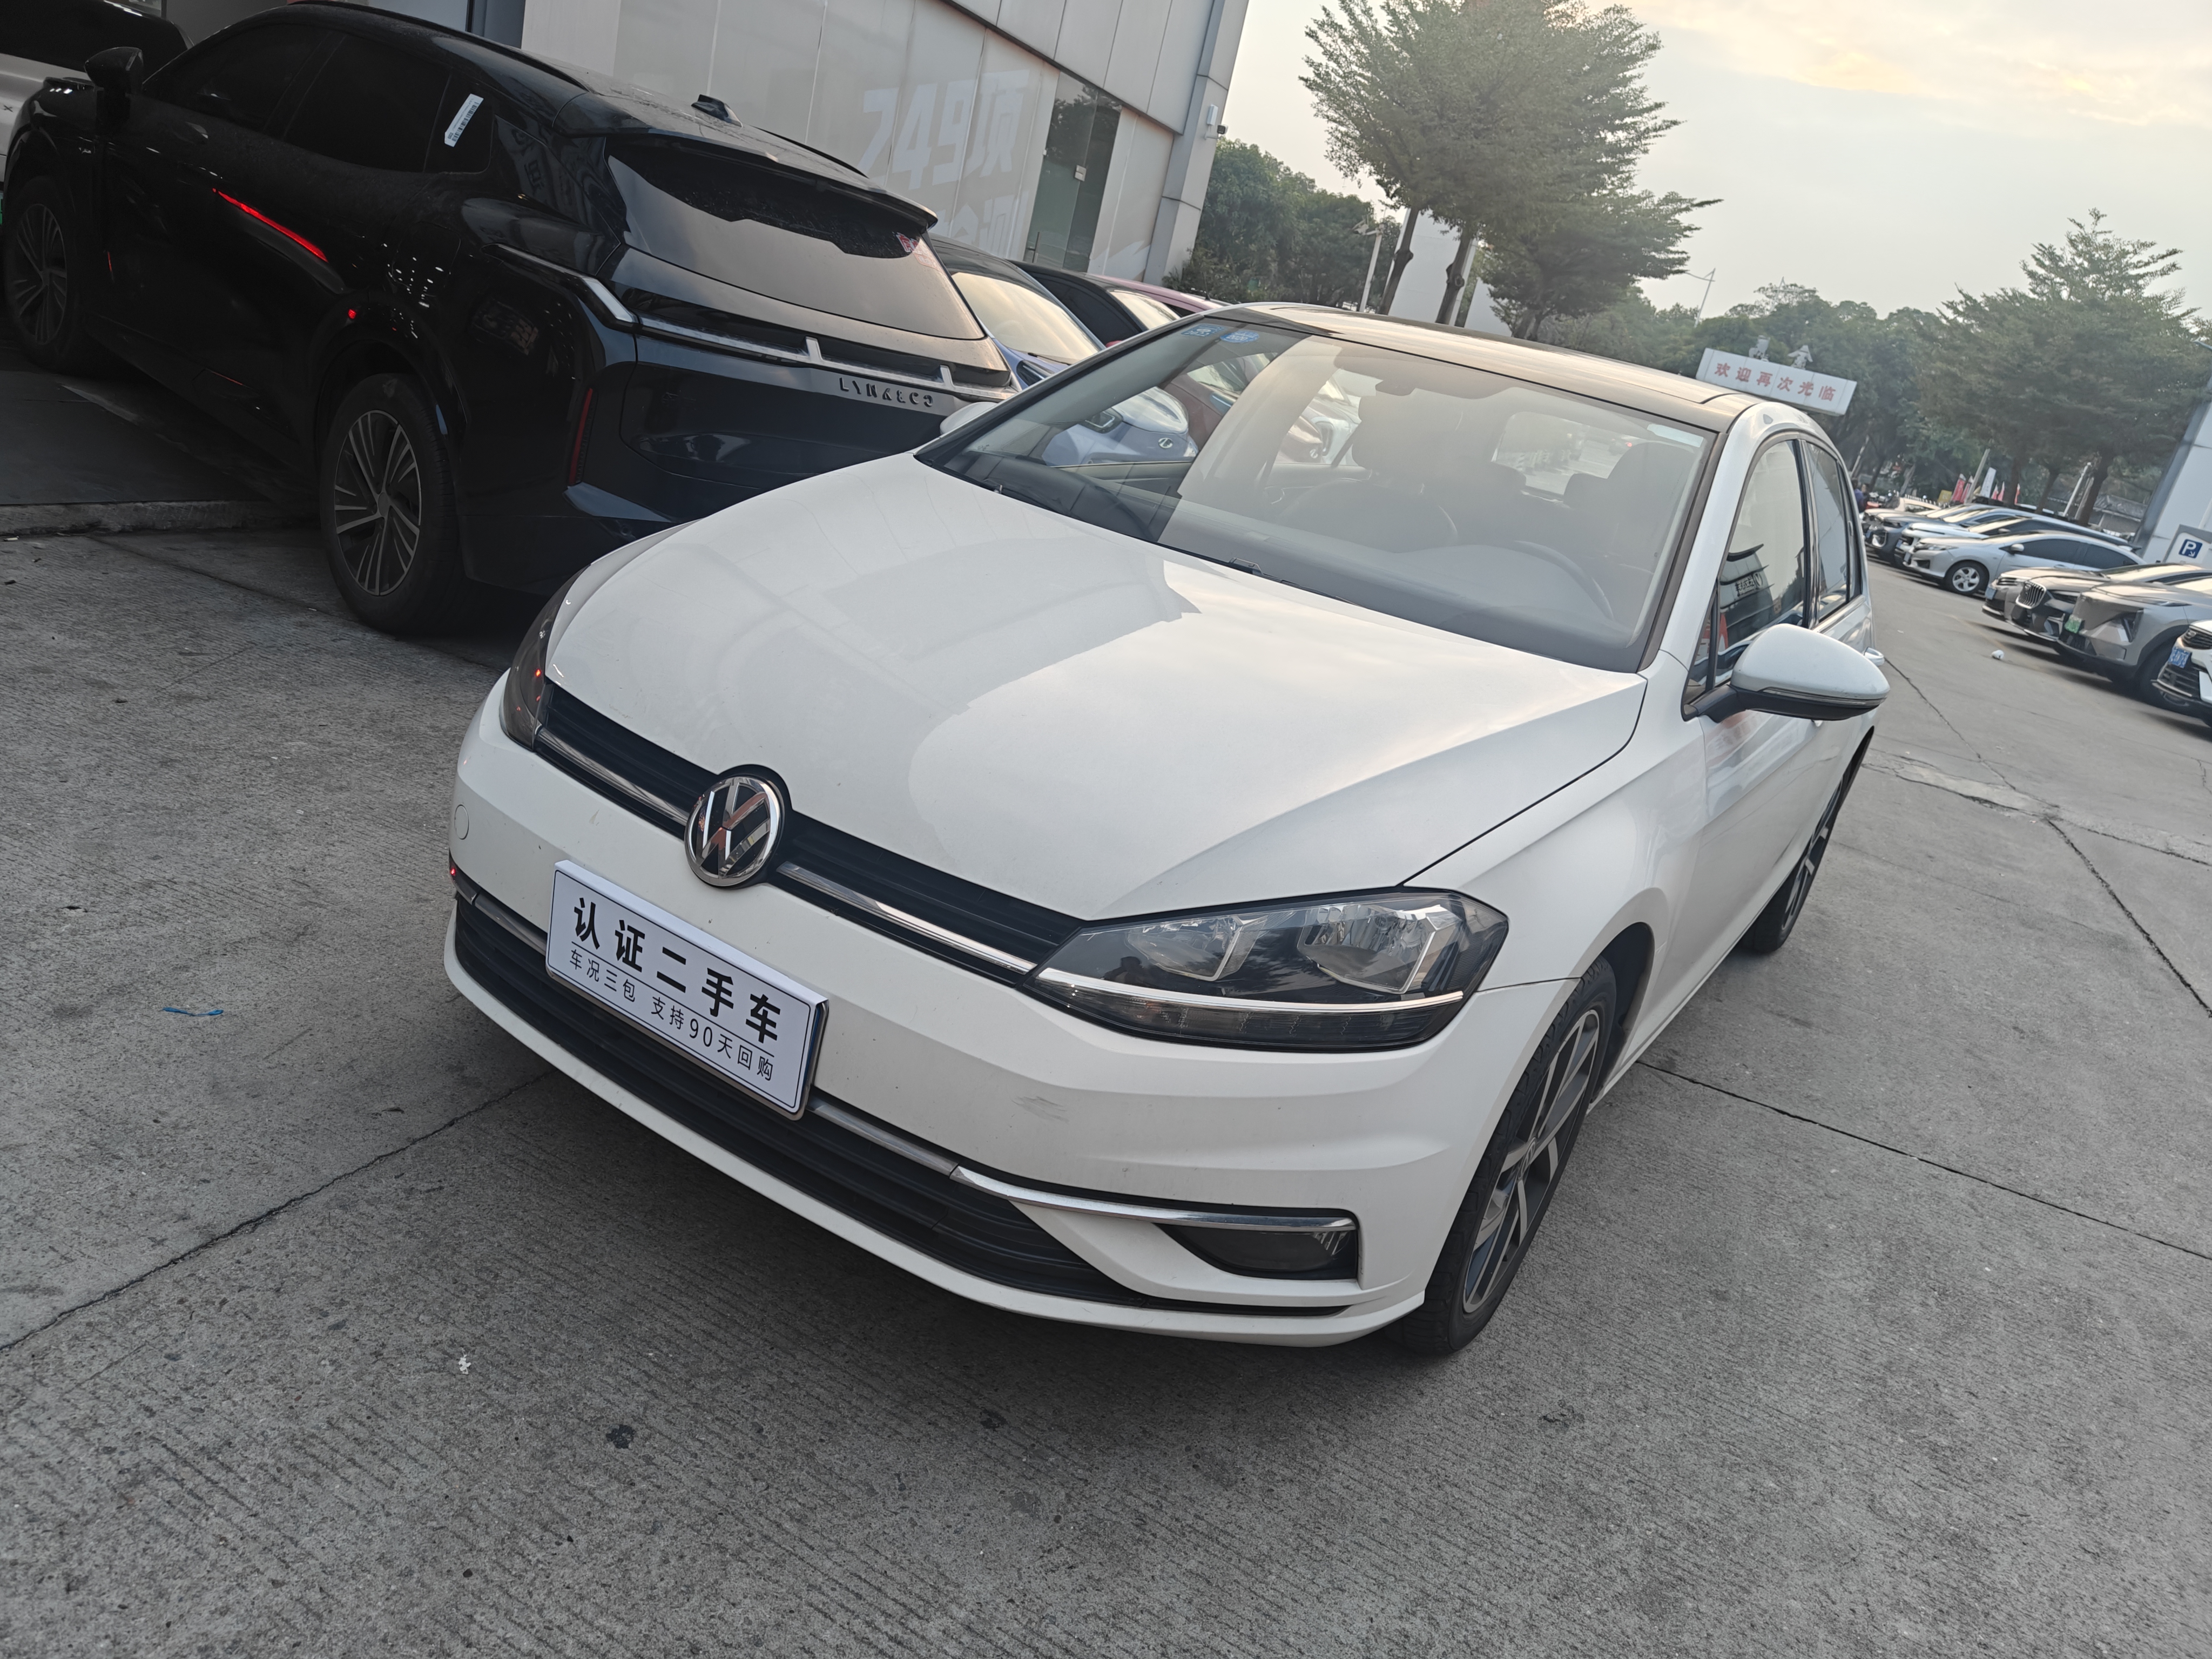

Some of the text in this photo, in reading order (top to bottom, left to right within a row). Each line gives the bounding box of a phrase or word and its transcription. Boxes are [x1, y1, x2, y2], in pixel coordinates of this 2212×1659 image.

[1715, 363, 1836, 401] 欢迎再次光临
[2182, 541, 2196, 555] P
[574, 898, 781, 1044] 认证二手车
[570, 949, 773, 1081] 车况三包 支持90天回购
